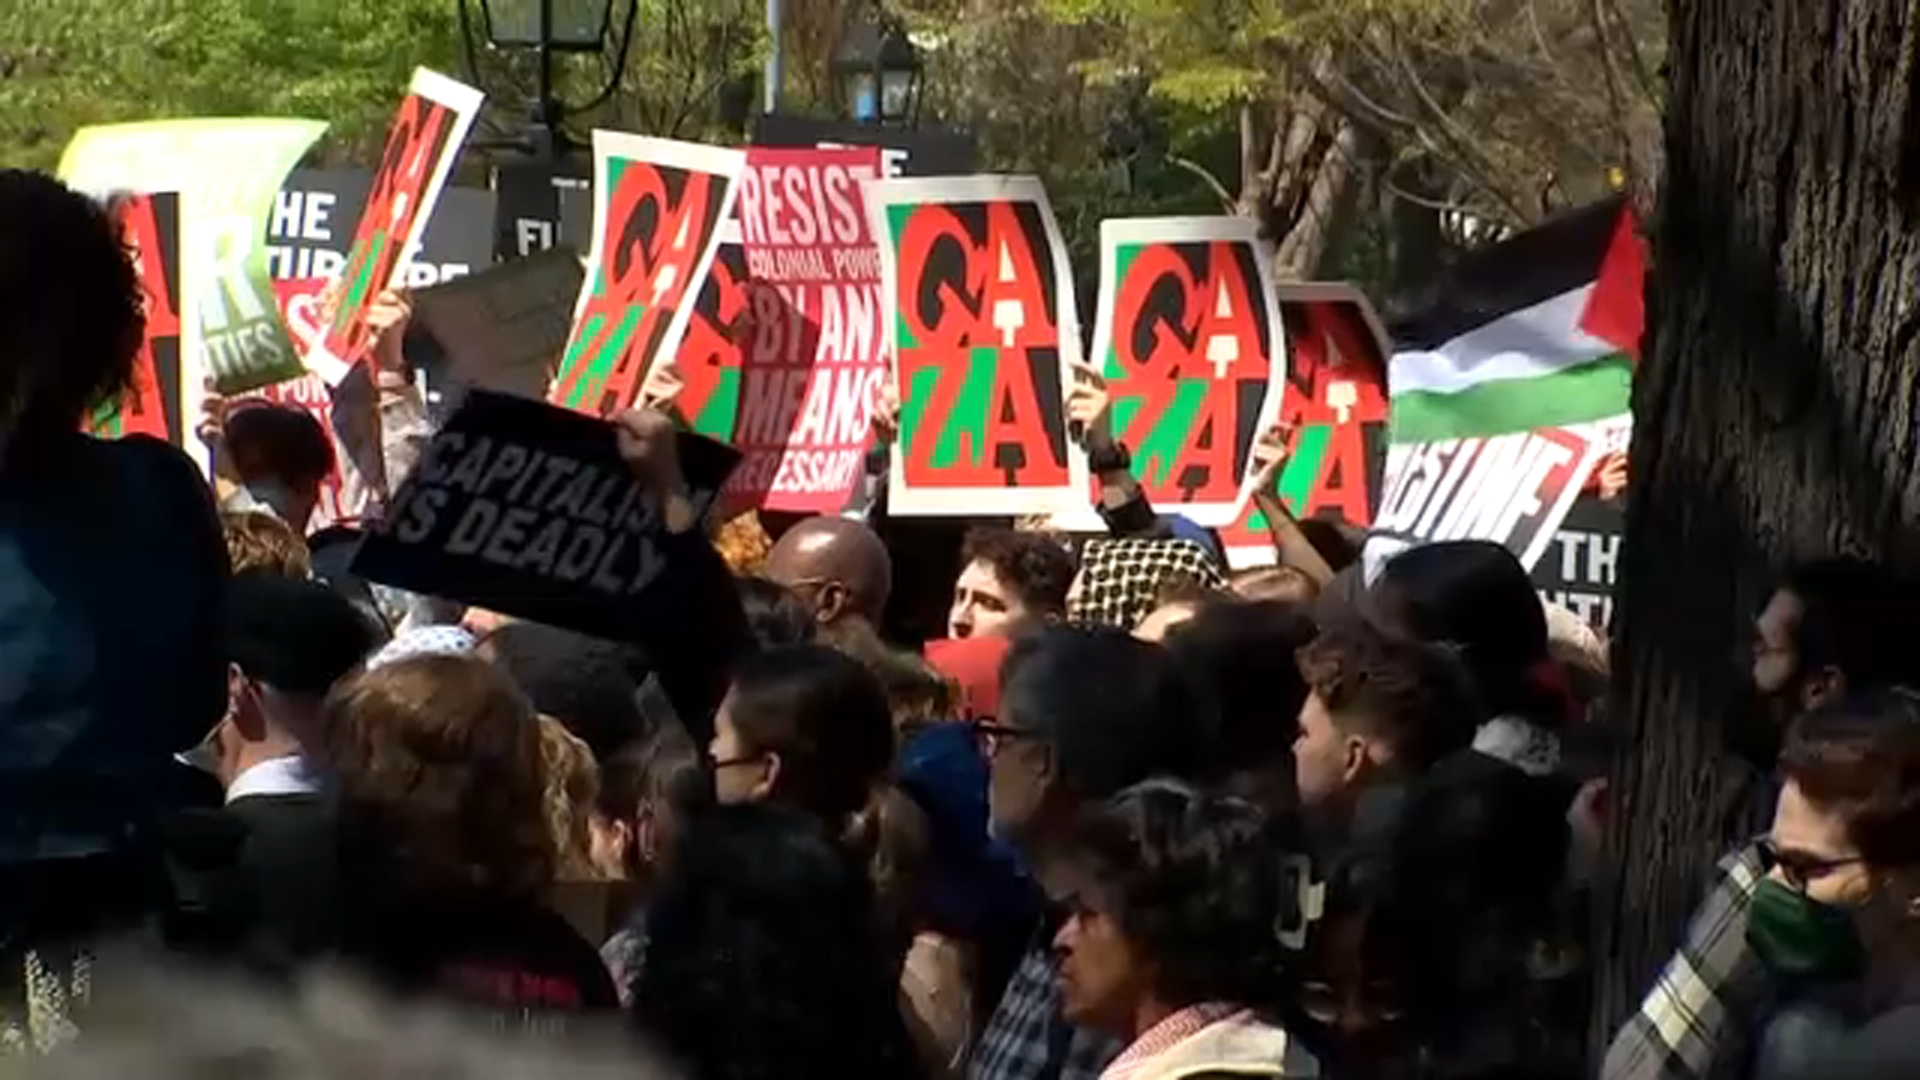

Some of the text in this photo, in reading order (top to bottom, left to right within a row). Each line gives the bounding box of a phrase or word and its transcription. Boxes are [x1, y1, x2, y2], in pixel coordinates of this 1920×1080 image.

[740, 164, 878, 245] RESIST
[737, 367, 886, 446] MEANS
[426, 430, 713, 536] CAPITALIS
[443, 497, 669, 595] DEADLY
